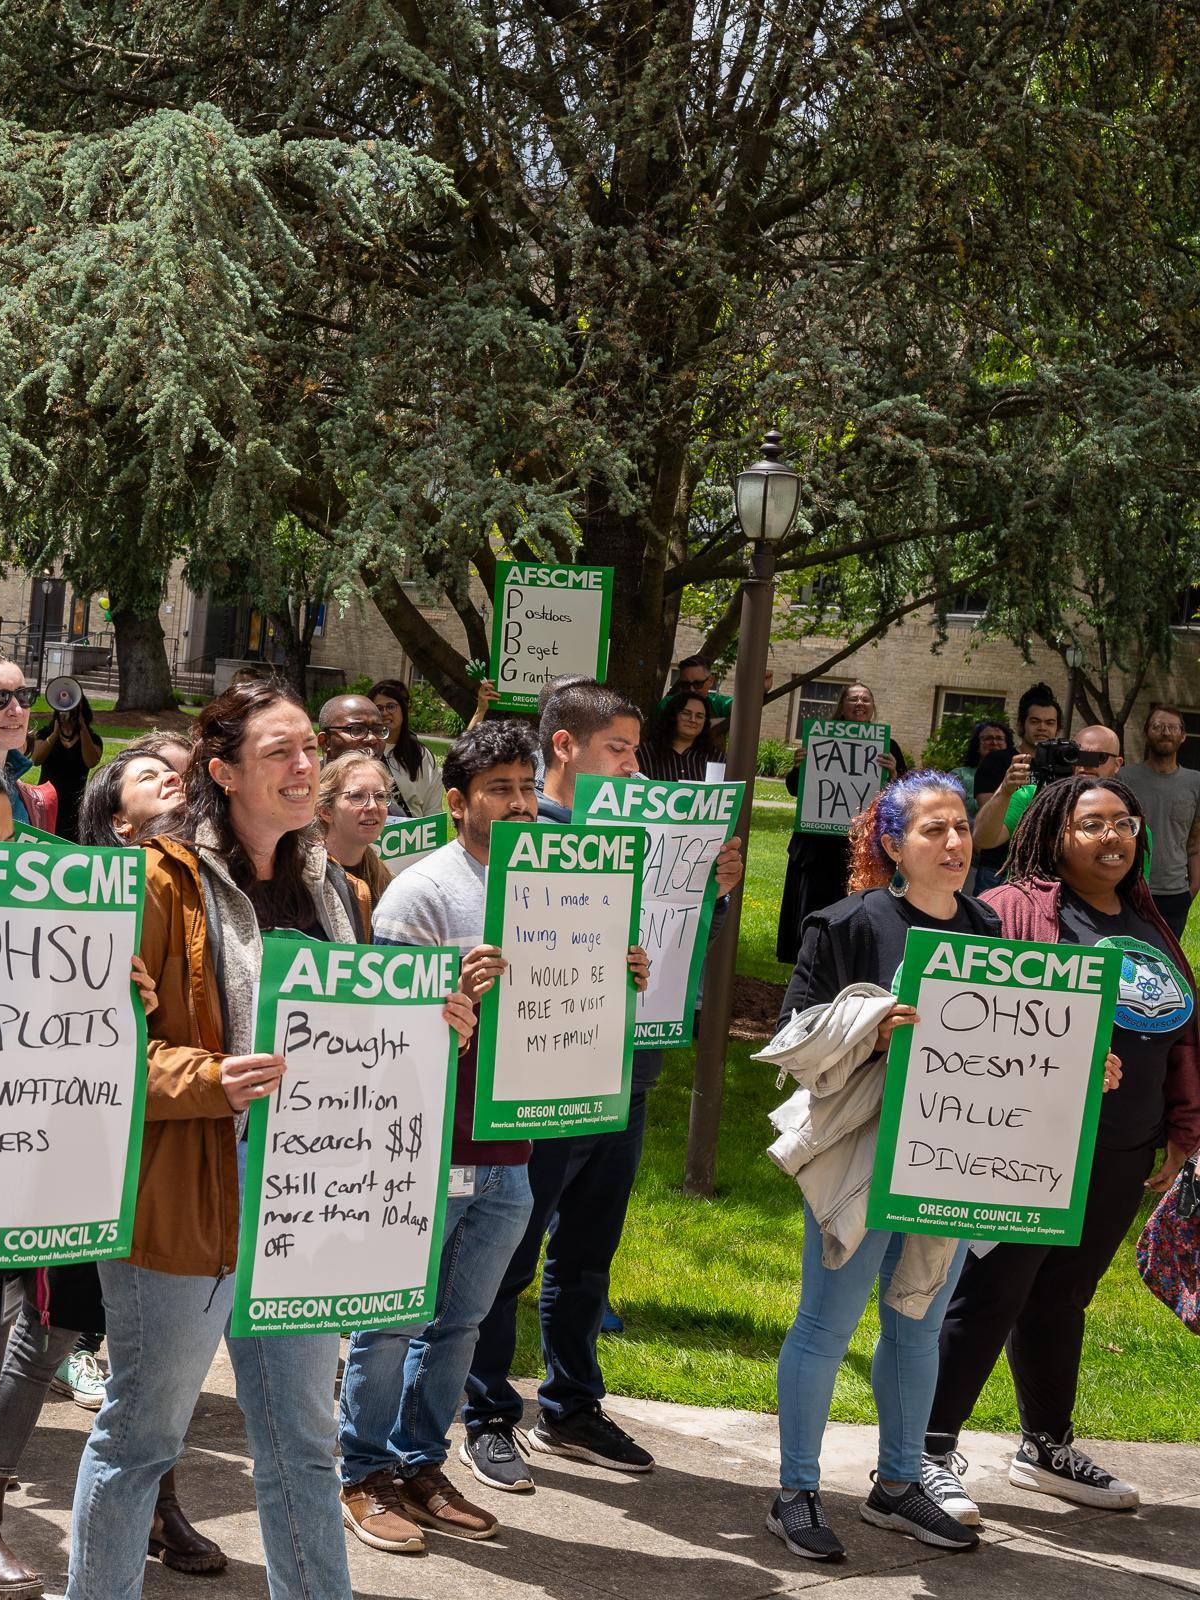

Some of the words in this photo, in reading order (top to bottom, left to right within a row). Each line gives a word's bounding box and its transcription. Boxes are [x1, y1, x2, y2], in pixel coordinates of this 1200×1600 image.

[505, 566, 602, 589] AFSCME
[809, 721, 885, 740] AFSCME
[812, 739, 879, 778] FAIR
[587, 784, 737, 821] AFSCME
[818, 779, 871, 818] PAY
[800, 822, 831, 830] OREGON
[507, 831, 635, 871] AFSCME
[514, 884, 530, 909] If
[545, 886, 550, 908] I
[560, 894, 590, 908] made
[602, 895, 611, 907] a
[515, 925, 557, 951] living
[571, 932, 603, 952] wage
[279, 948, 453, 999] AFSCME
[508, 964, 513, 986] I
[530, 965, 580, 988] WOULD
[591, 965, 606, 985] BE
[923, 942, 1105, 991] AFSCME
[517, 999, 551, 1020] ABLE
[561, 999, 577, 1016] TO
[579, 995, 607, 1011] VISIT
[940, 991, 1071, 1037] OHSU
[1117, 1011, 1148, 1028] OREGON
[282, 1010, 410, 1068] Brought
[527, 1034, 551, 1053] MY
[553, 1023, 599, 1052] FAMILY!
[668, 1023, 683, 1036] 75
[318, 1085, 398, 1111] million
[517, 1105, 555, 1118] OREGON
[558, 1103, 591, 1116] COUNCIL
[593, 1101, 603, 1113] 75
[919, 1092, 1032, 1127] VALUE
[272, 1127, 372, 1155] research
[385, 1112, 424, 1162] $$
[491, 1121, 514, 1129] American
[516, 1120, 541, 1128] Federation
[908, 1140, 1062, 1192] DIVERSITY
[265, 1172, 317, 1199] Still
[325, 1174, 379, 1197] can't
[383, 1176, 417, 1204] get
[264, 1206, 313, 1228] more
[318, 1204, 370, 1224] than
[381, 1205, 399, 1228] 10
[400, 1201, 429, 1236] days
[886, 1213, 915, 1222] American
[916, 1216, 948, 1226] Federation
[949, 1219, 957, 1227] of
[958, 1220, 975, 1229] State,
[976, 1222, 996, 1232] County
[997, 1223, 1008, 1231] and
[1010, 1224, 1036, 1233] Municipal
[1037, 1226, 1065, 1235] Employees
[918, 1203, 969, 1219] OREGON
[973, 1208, 1022, 1223] COUNCIL
[1026, 1212, 1040, 1224] 75
[4, 1226, 91, 1249] COUNCIL
[96, 1222, 118, 1243] 75
[12, 1252, 38, 1263] County
[39, 1251, 52, 1261] and
[52, 1249, 82, 1261] Municipal
[83, 1246, 112, 1258] Employees
[249, 1300, 332, 1320] OREGON
[335, 1293, 404, 1316] COUNCIL
[407, 1289, 425, 1308] 75
[251, 1323, 282, 1331] American
[282, 1321, 315, 1330] Federation
[316, 1320, 323, 1329] of
[323, 1320, 340, 1329] State,
[341, 1318, 362, 1329] County
[362, 1316, 373, 1325] and
[373, 1314, 397, 1325] Municipal
[397, 1312, 420, 1322] Employees
